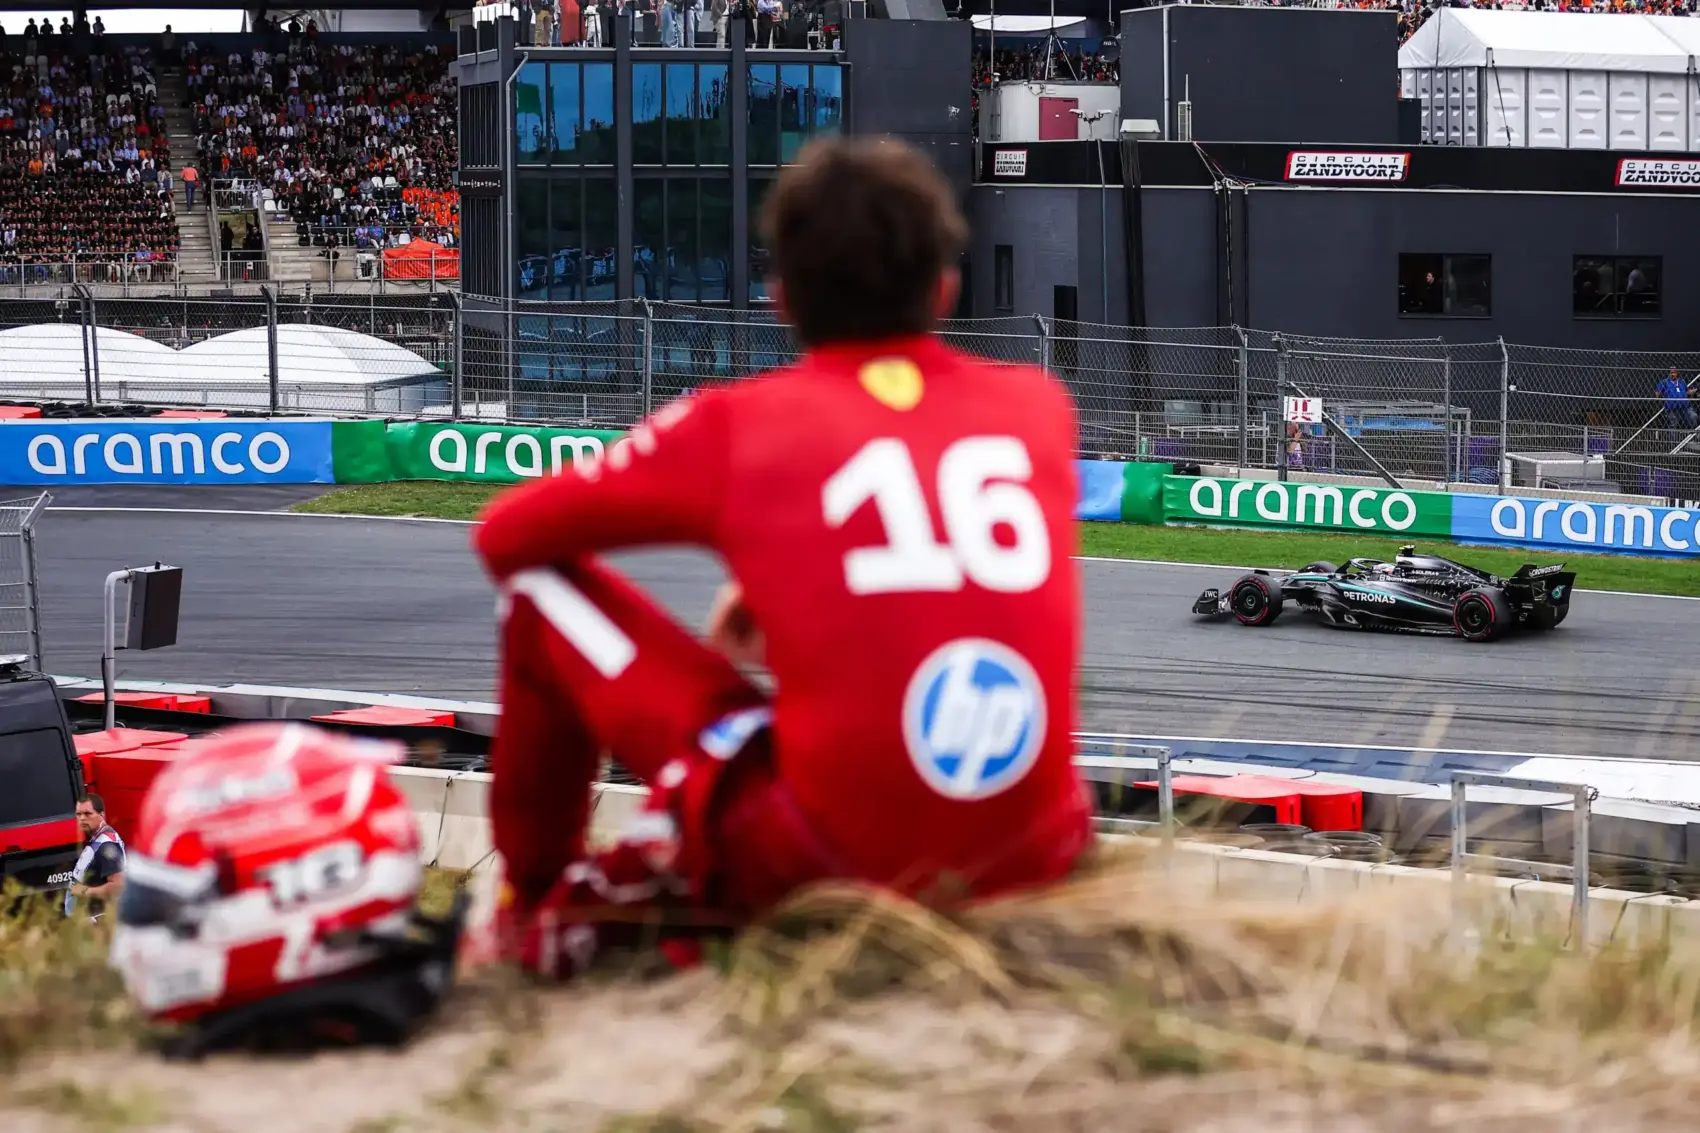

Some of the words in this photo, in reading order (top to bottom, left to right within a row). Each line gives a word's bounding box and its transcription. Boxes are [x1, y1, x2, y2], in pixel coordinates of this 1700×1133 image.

[1294, 163, 1399, 177] ZANDVOORT
[1297, 155, 1400, 163] CIRCUIT
[27, 431, 291, 475] aramco
[429, 429, 634, 477] aram
[821, 434, 1051, 595] 16
[1189, 478, 1417, 530] aramco
[1204, 590, 1218, 598] IWC
[1343, 591, 1396, 604] PETRONAS
[920, 642, 1038, 799] hp
